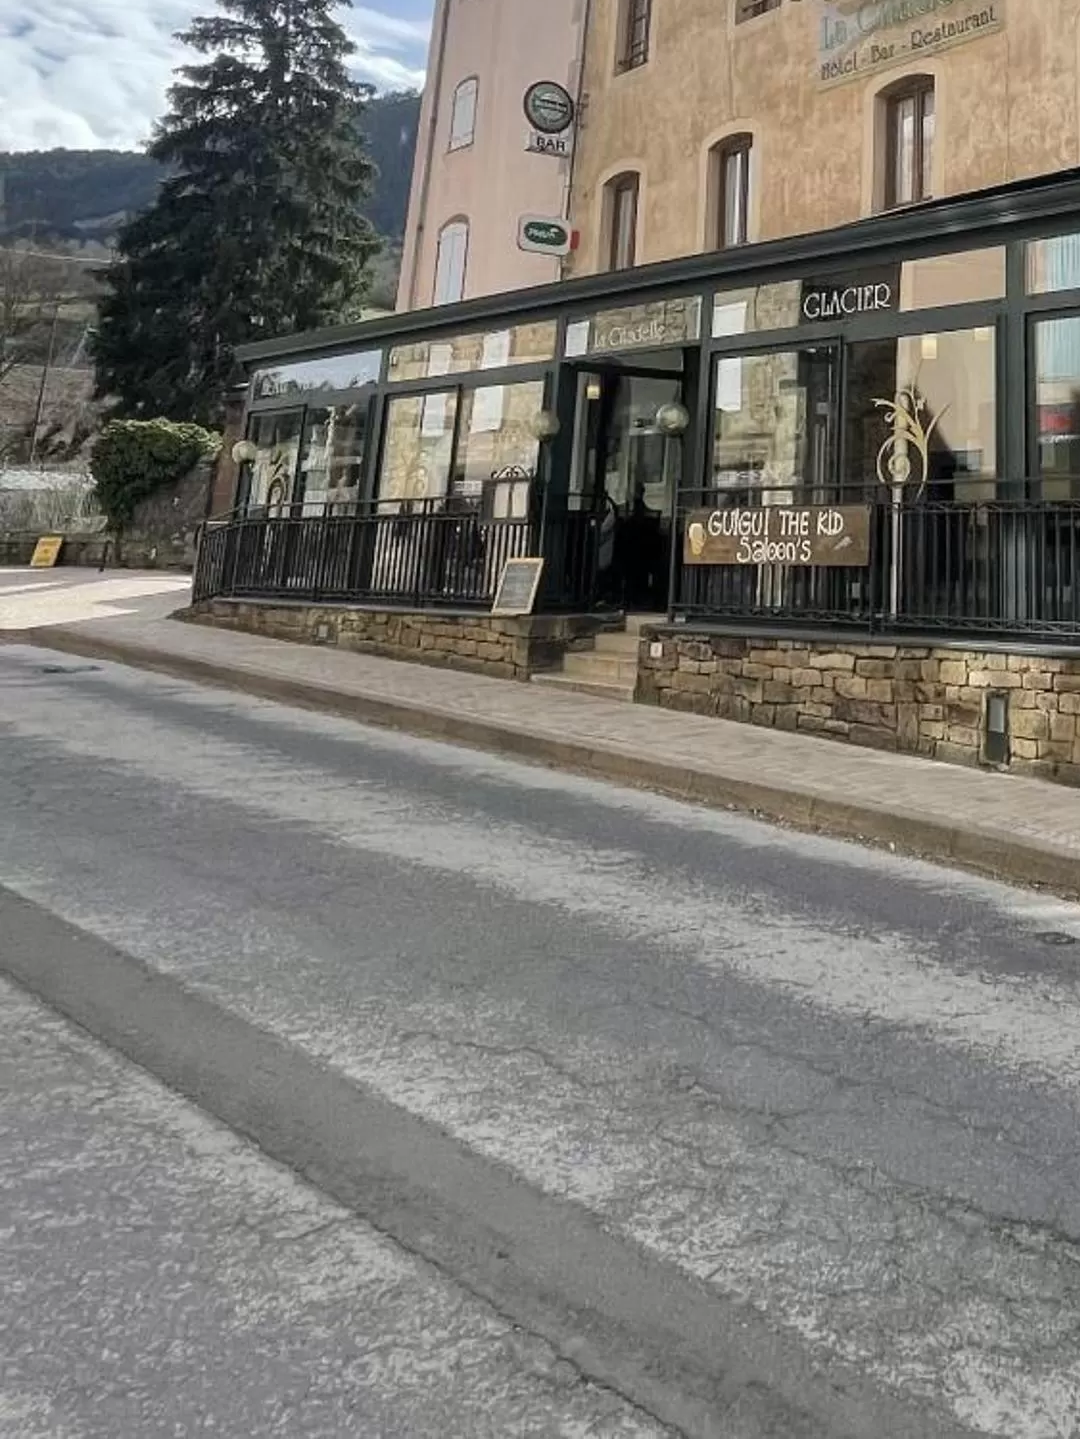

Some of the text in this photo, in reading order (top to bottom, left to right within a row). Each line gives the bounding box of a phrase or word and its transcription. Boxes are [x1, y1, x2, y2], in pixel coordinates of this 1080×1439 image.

[536, 136, 566, 152] BAR
[803, 283, 892, 319] GLACIER
[780, 510, 810, 537] THE
[736, 536, 812, 563] Saloon's
